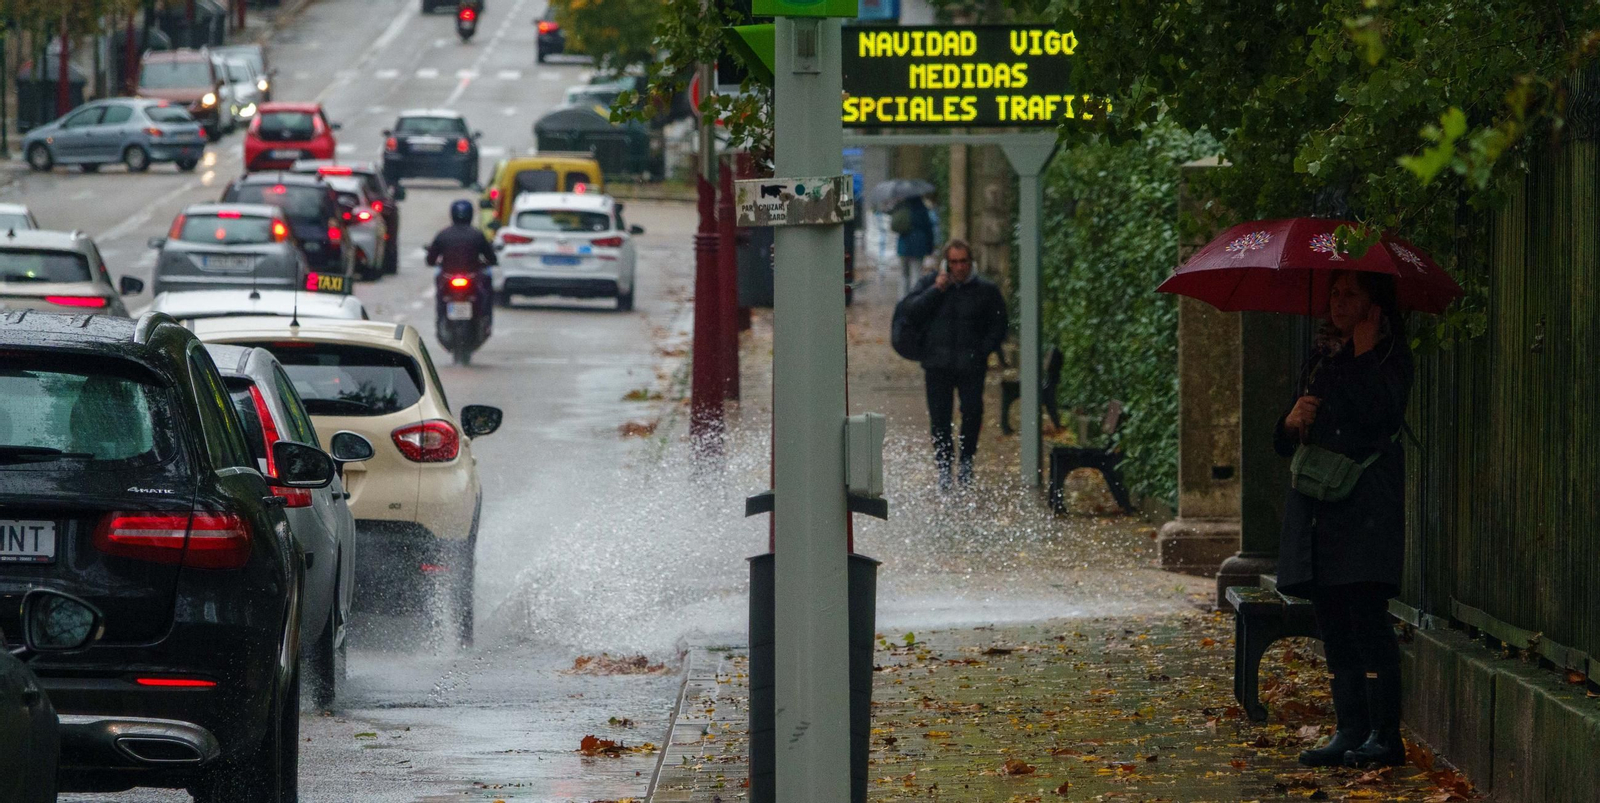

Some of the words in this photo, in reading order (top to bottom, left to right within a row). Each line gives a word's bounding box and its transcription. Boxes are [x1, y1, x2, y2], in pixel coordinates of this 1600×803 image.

[858, 31, 978, 58] NAVIDAD
[1010, 29, 1079, 56] VIGO
[909, 63, 1028, 89] MEDIDAS
[842, 95, 977, 122] SPCIALES
[995, 94, 1113, 121] TRAFI
[741, 204, 753, 212] PAR
[318, 276, 343, 291] TAXI
[127, 486, 175, 494] 4MATIC
[0, 525, 45, 552] NT
